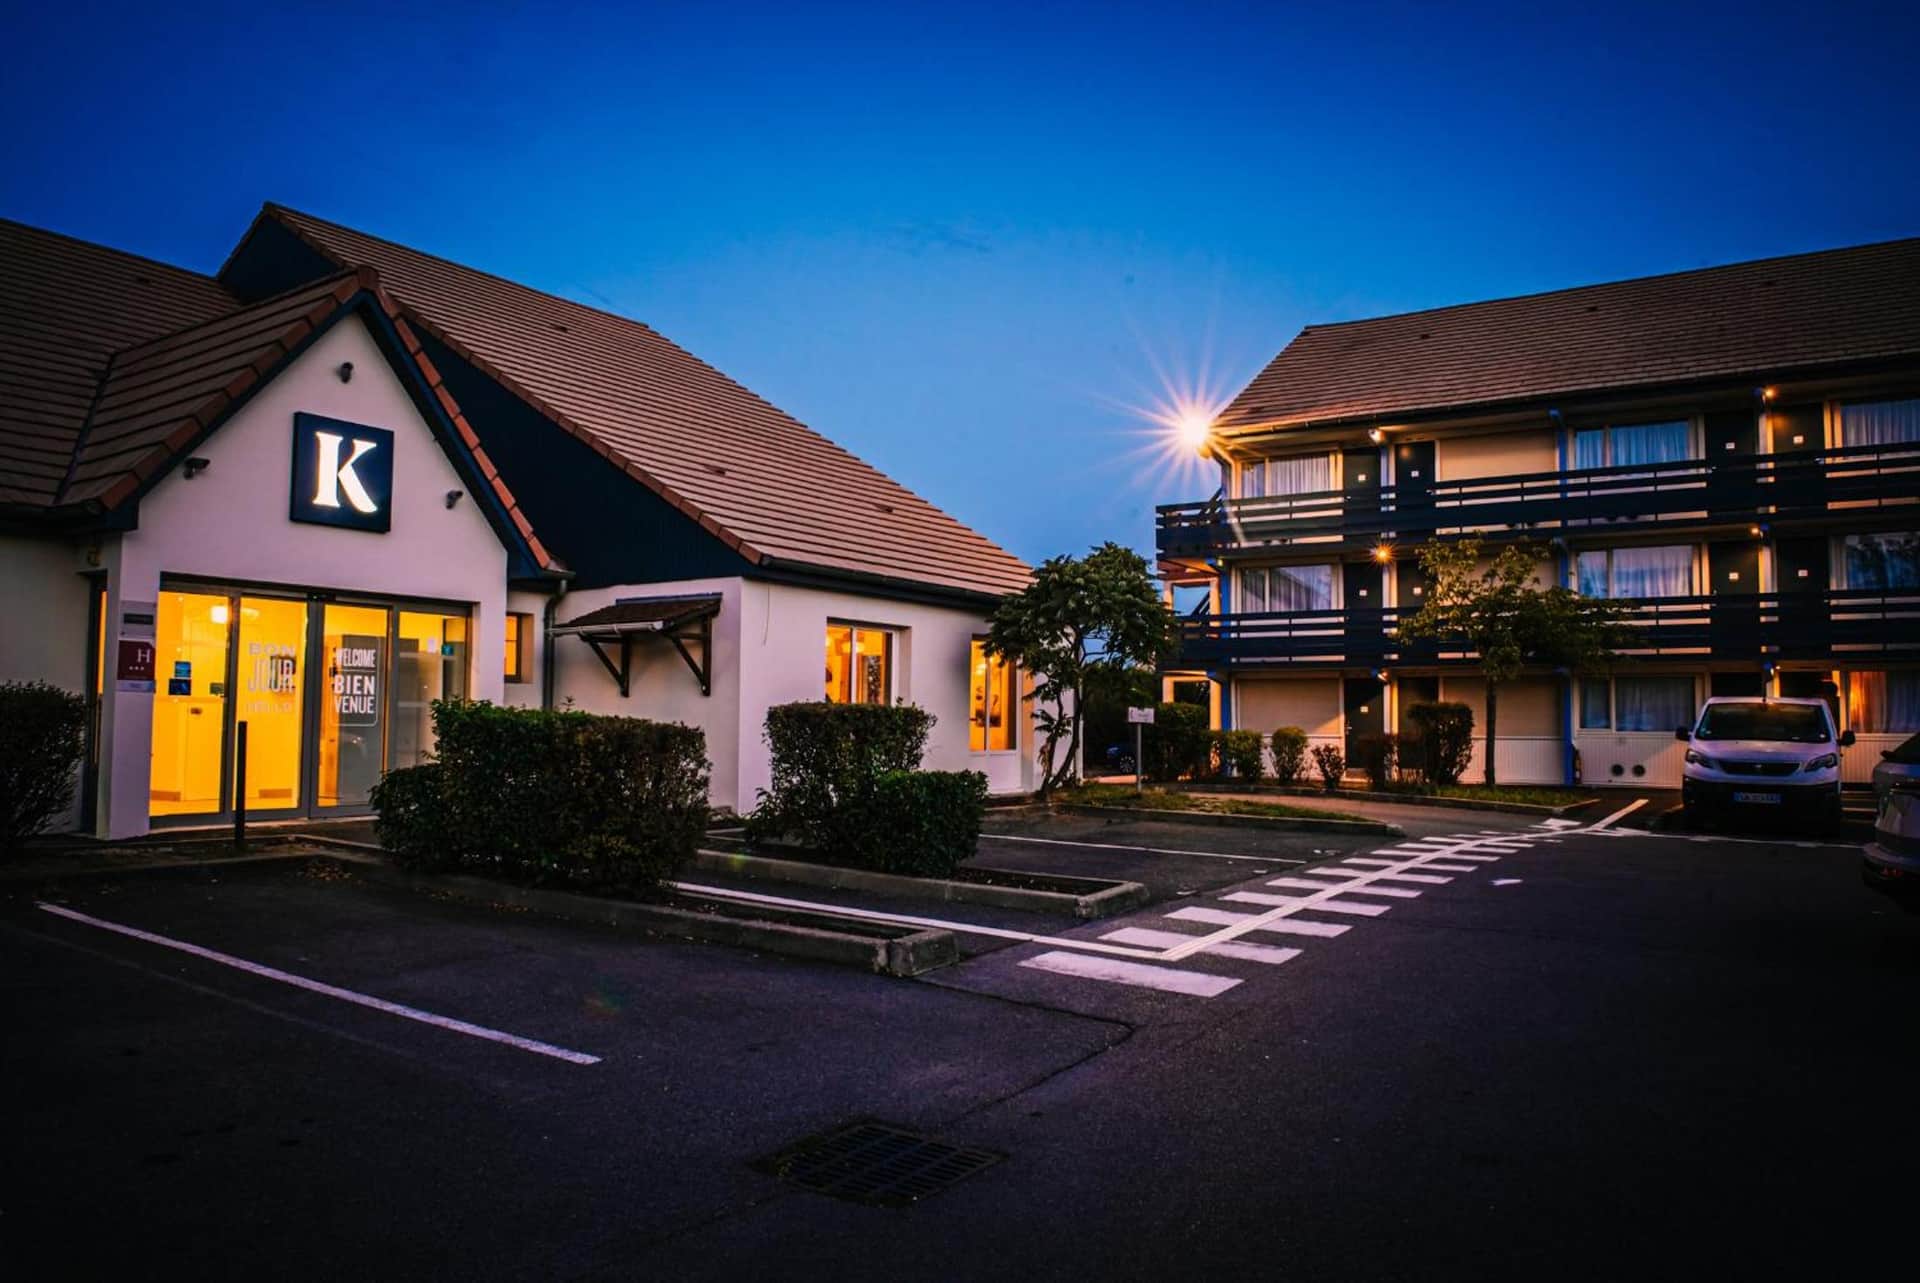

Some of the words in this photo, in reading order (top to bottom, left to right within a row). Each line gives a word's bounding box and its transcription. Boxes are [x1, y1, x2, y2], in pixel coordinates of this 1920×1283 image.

[312, 431, 378, 513] K
[137, 648, 151, 663] H
[249, 642, 296, 657] BON
[334, 648, 376, 668] WELCOME
[248, 658, 295, 693] JOUR
[333, 674, 376, 695] BIEN
[334, 695, 375, 714] VENUE
